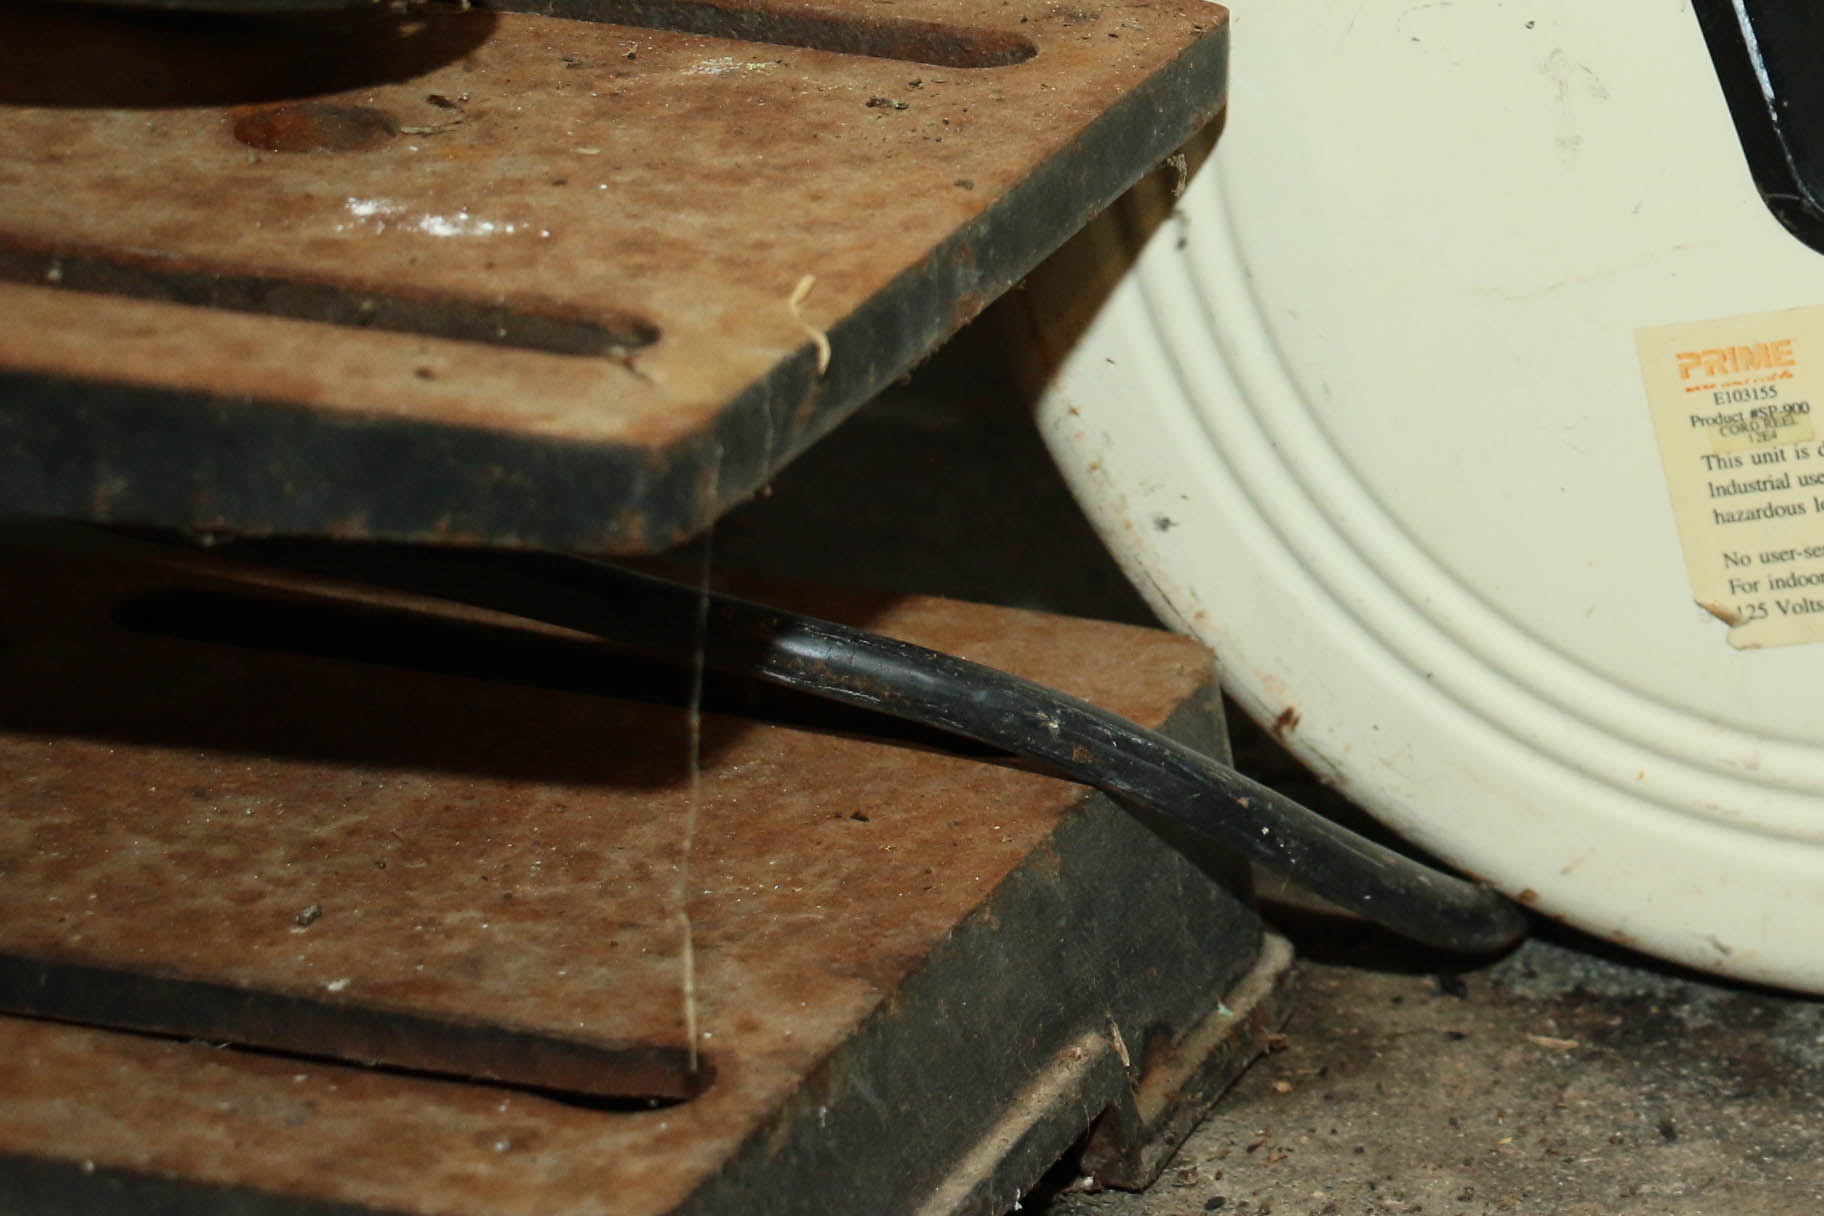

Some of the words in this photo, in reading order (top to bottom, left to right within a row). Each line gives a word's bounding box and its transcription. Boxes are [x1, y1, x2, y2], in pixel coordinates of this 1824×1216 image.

[1676, 338, 1797, 381] PRIME
[1714, 386, 1778, 406] E103155
[1690, 409, 1744, 429] Product
[1749, 401, 1811, 421] #SP-900
[1701, 454, 1743, 472] This
[1751, 446, 1787, 466] unit
[1795, 444, 1810, 460] is
[1708, 472, 1791, 499] Industrial
[1713, 499, 1807, 525] hazardous
[1722, 551, 1751, 570] No
[1728, 576, 1760, 595] For
[1775, 595, 1824, 618] Volts
